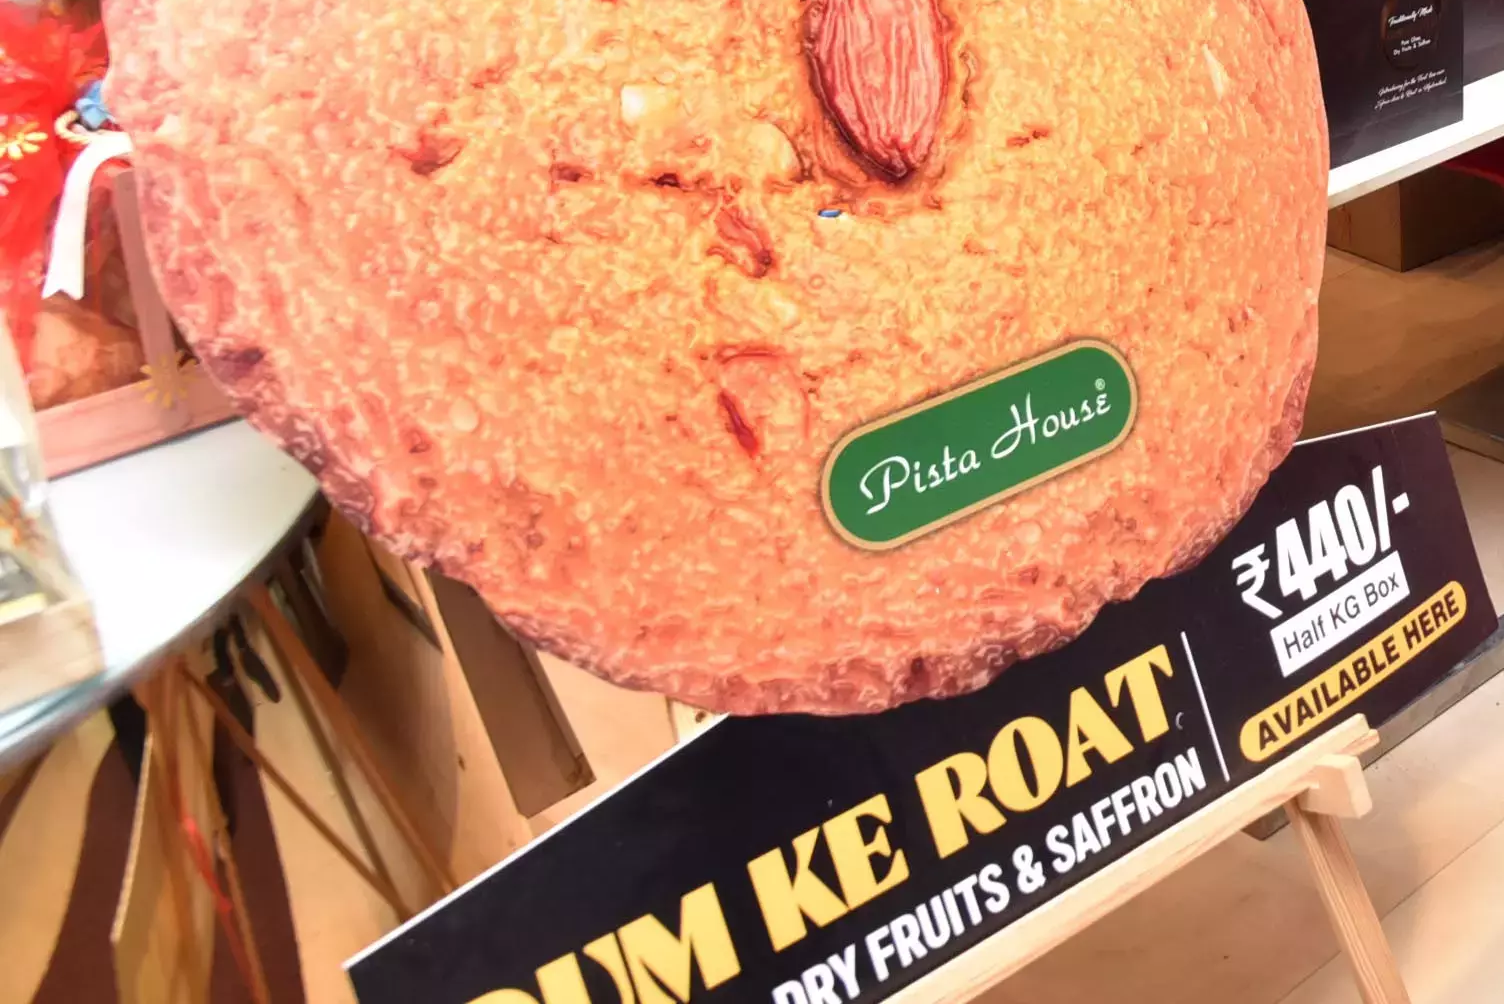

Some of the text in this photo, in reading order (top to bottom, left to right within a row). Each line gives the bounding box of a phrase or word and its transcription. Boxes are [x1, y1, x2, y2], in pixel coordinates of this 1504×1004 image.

[859, 445, 981, 515] Pista
[1258, 589, 1460, 751] AVAILABLE HERE
[1282, 572, 1401, 659] Half KG Box
[463, 643, 1173, 1004] UM KE ROAT
[864, 863, 1010, 983] FRUITS
[1012, 844, 1047, 896] &
[1045, 746, 1207, 874] SAFFRON
